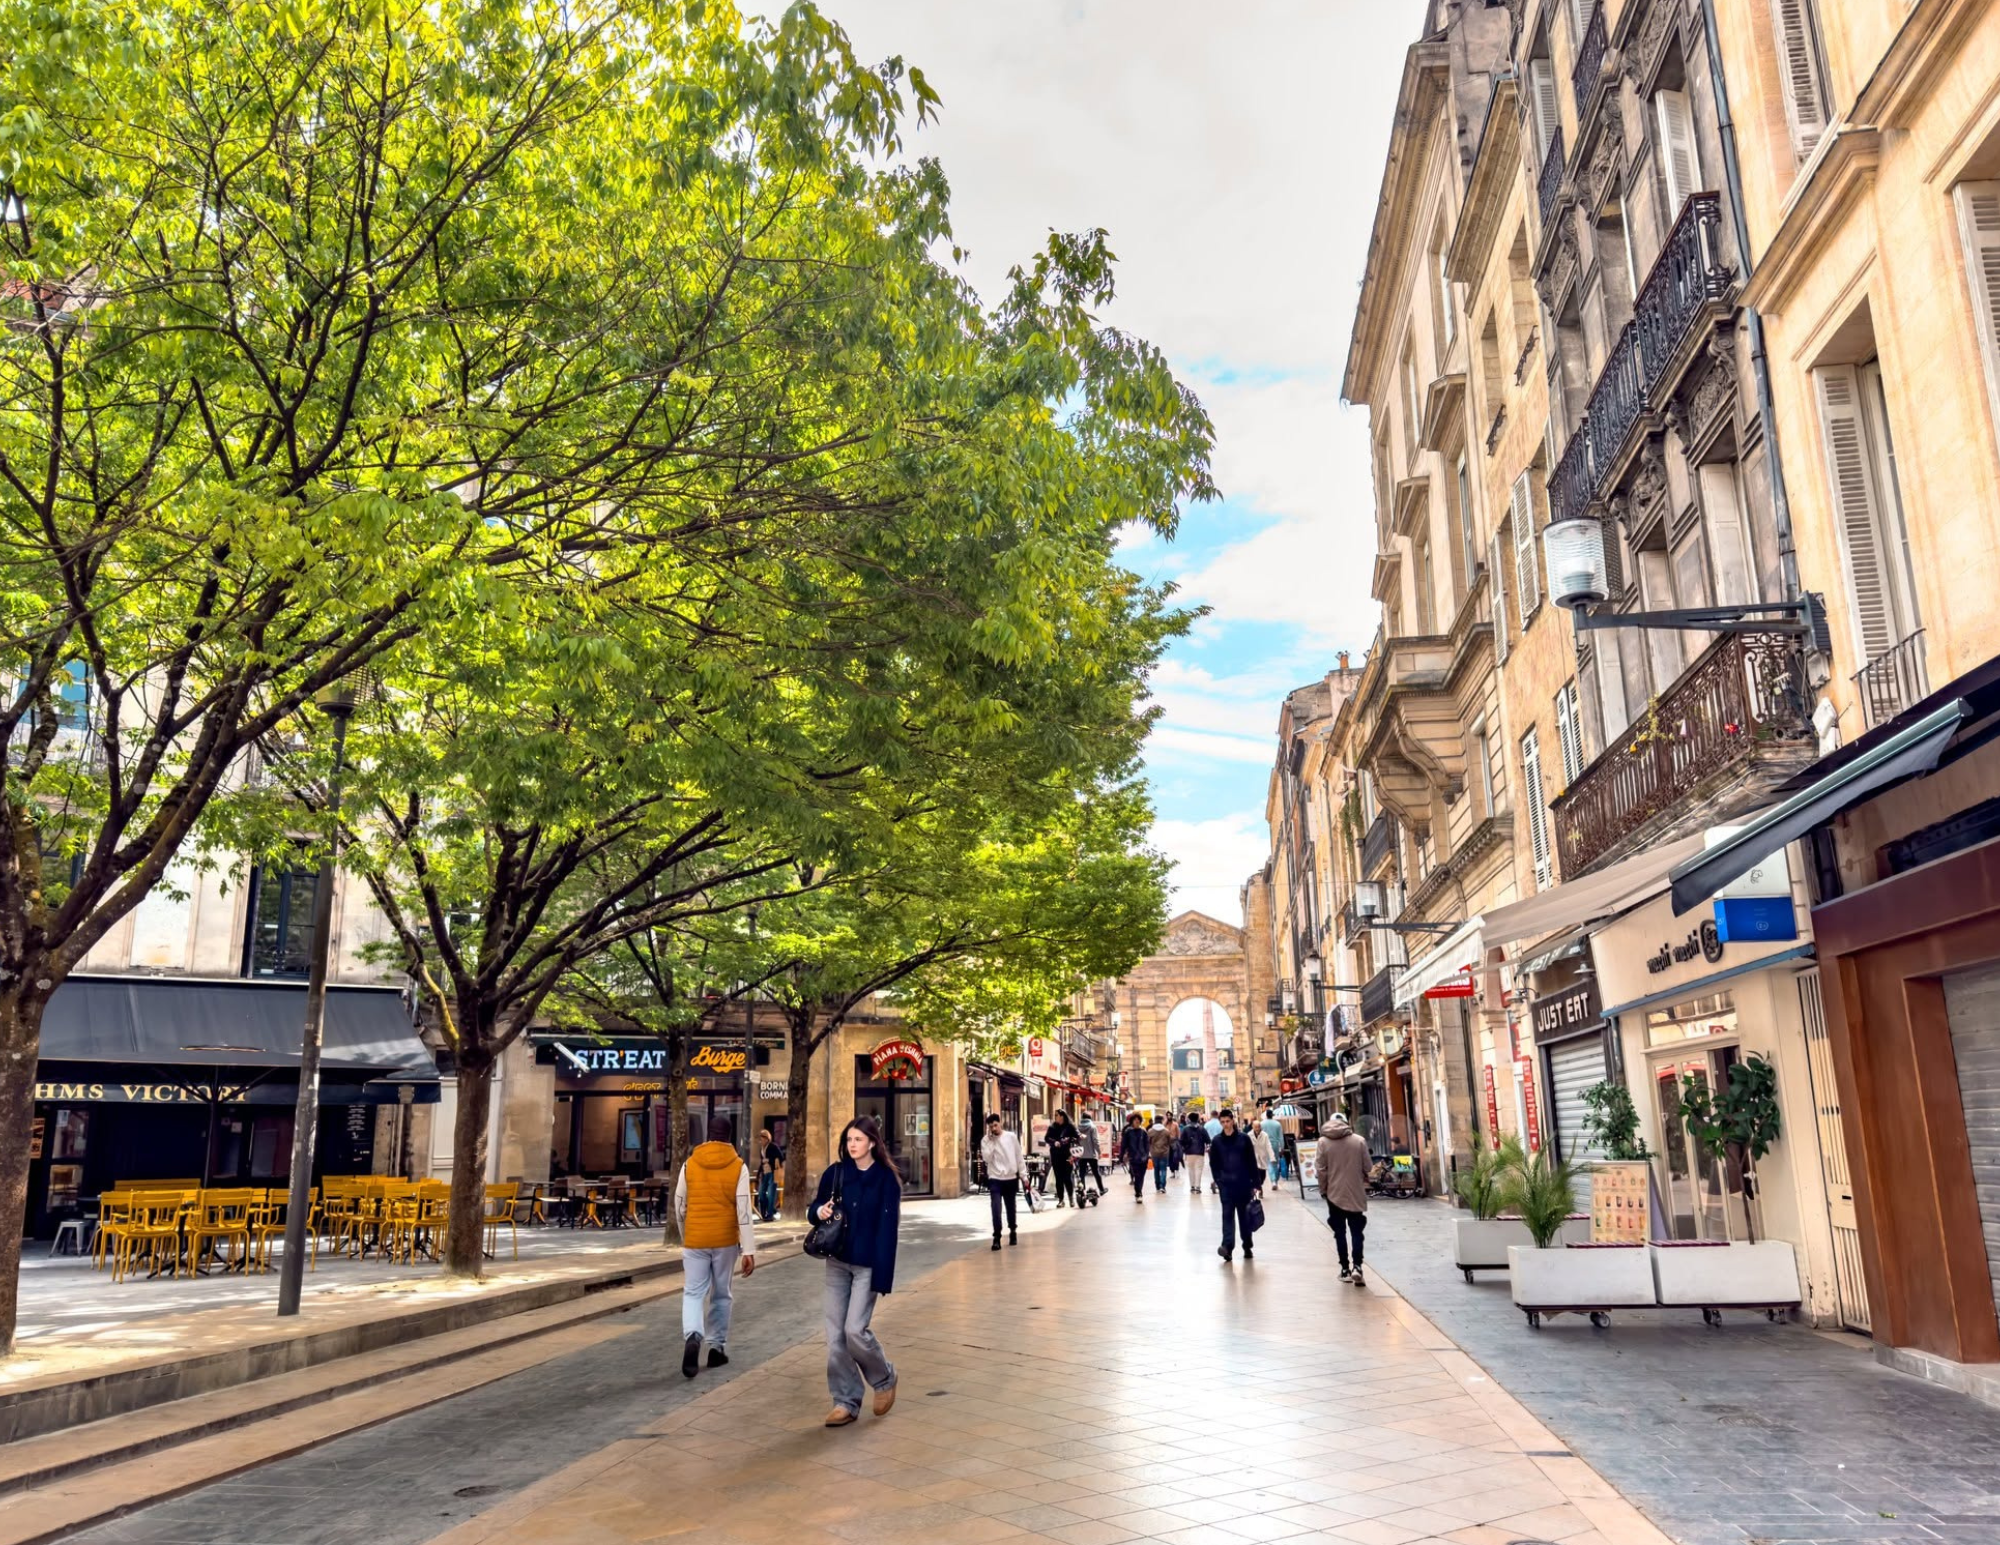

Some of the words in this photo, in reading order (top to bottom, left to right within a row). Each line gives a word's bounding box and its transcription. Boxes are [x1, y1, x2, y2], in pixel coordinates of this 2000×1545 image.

[1538, 1002, 1562, 1032] JUST
[1566, 992, 1588, 1023] EAT
[574, 1050, 666, 1069] STR'EAT
[690, 1046, 745, 1073] Burge
[35, 1084, 103, 1099] HMS
[121, 1085, 249, 1101] VICTORY
[760, 1091, 788, 1100] COMMA
